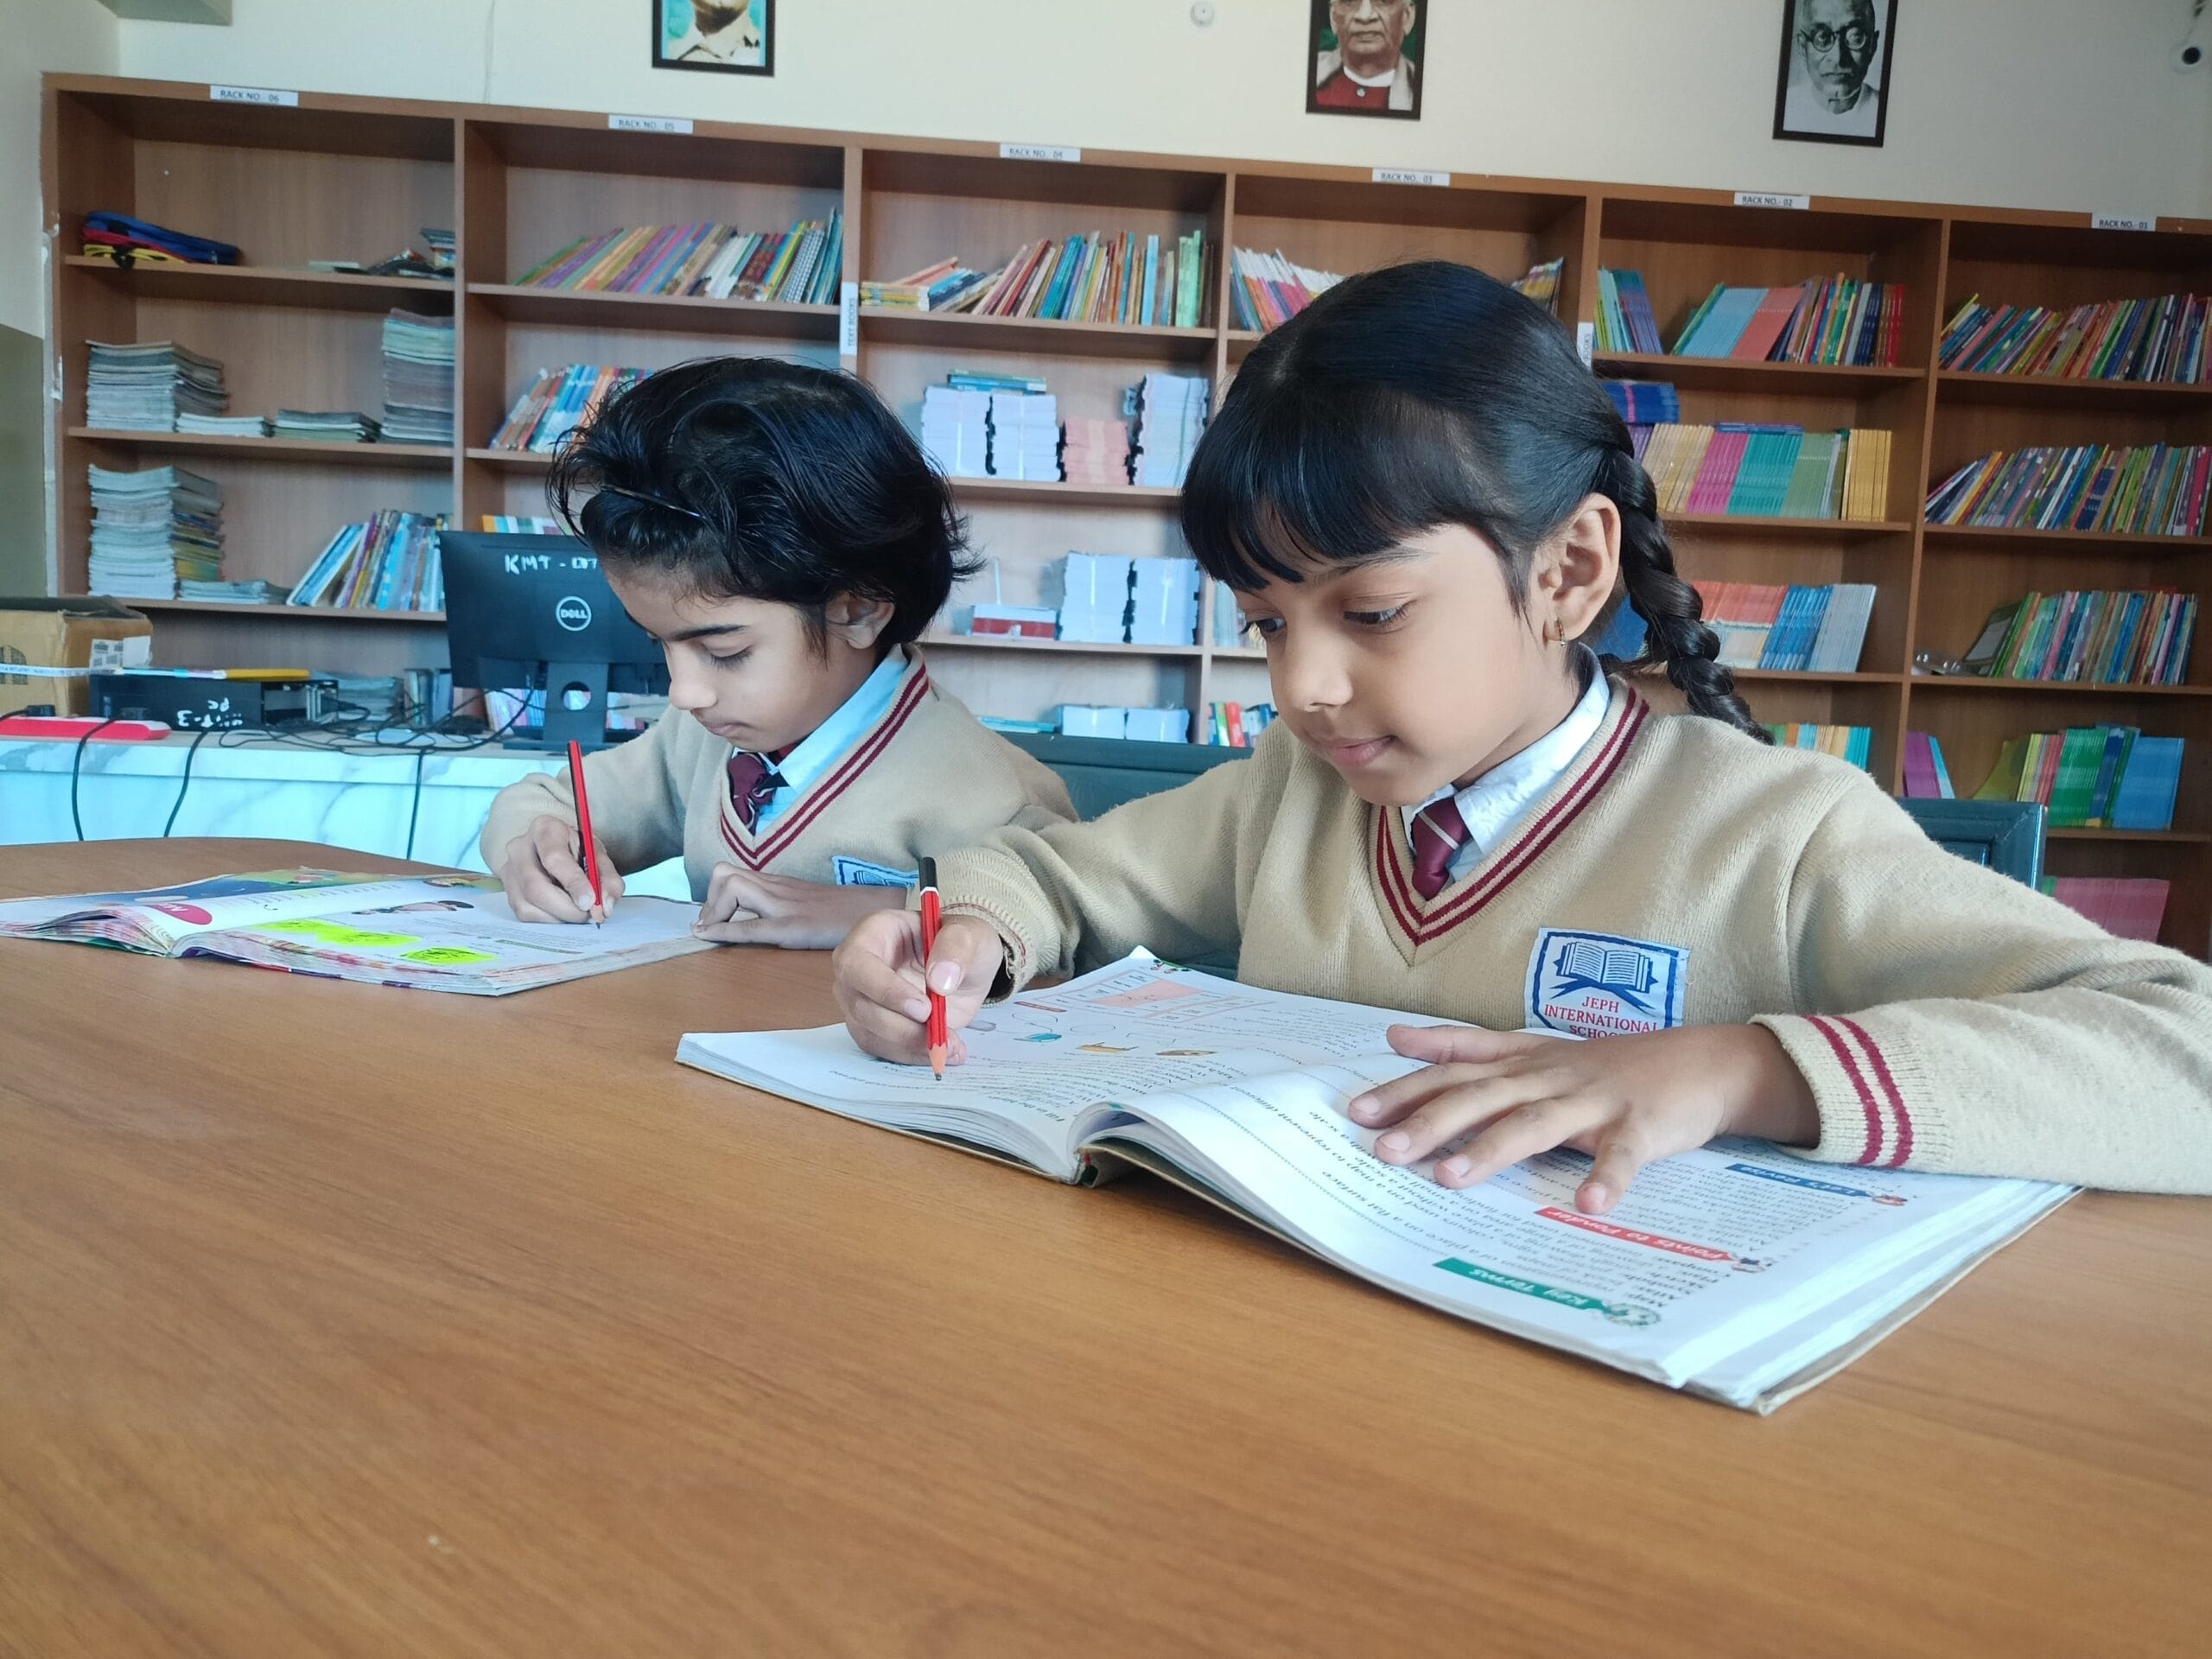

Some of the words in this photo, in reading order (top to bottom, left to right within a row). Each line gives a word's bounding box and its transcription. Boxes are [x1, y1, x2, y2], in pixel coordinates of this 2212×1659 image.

[220, 89, 244, 99] RACK
[268, 93, 280, 103] 06
[618, 119, 640, 128] RACK
[1009, 148, 1030, 156] RACK
[1052, 150, 1063, 159] 04
[1381, 172, 1402, 181] RACK
[1742, 195, 1763, 204] RACK
[1783, 198, 1793, 207] 02
[2099, 219, 2119, 228] RACK
[561, 609, 588, 619] DELL
[1581, 996, 1619, 1014] JEPH
[1230, 1084, 1278, 1114] different
[1306, 1111, 1339, 1132] scale
[1276, 1112, 1332, 1151] represent
[1329, 1152, 1345, 1161] to
[1344, 1162, 1375, 1181] map
[1351, 1156, 1388, 1177] scale
[1697, 1174, 1735, 1184] show
[1724, 1175, 1759, 1184] used
[1740, 1166, 1801, 1184] Revise
[1319, 1171, 1368, 1202] surface
[1409, 1180, 1446, 1199] small
[1509, 1181, 1549, 1198] place
[1685, 1185, 1724, 1194] show
[1694, 1180, 1733, 1190] show
[1737, 1183, 1779, 1194] maps
[1807, 1180, 1856, 1195] Let's
[1385, 1189, 1406, 1200] on
[1397, 1185, 1450, 1211] without
[1450, 1191, 1498, 1212] finding
[1692, 1192, 1770, 1210] represents
[1726, 1193, 1767, 1204] maps
[1736, 1189, 1777, 1199] maps
[1778, 1186, 1846, 1202] compass
[1367, 1202, 1389, 1217] flat
[1404, 1200, 1440, 1217] used
[1459, 1205, 1481, 1214] on
[1658, 1197, 1705, 1209] rough
[1700, 1200, 1782, 1219] landmarks
[1769, 1203, 1833, 1218] Political
[1777, 1198, 1843, 1214] Physical
[1448, 1211, 1491, 1229] place
[1481, 1215, 1515, 1227] area
[1500, 1212, 1521, 1221] for
[1636, 1213, 1675, 1224] book
[1736, 1215, 1783, 1227] sketch
[1770, 1209, 1808, 1218] plan
[1402, 1223, 1426, 1232] on
[1440, 1218, 1495, 1240] colours
[1520, 1220, 1560, 1233] used
[1547, 1209, 1622, 1237] Ponder
[1423, 1232, 1466, 1250] place
[1515, 1226, 1551, 1241] large
[1628, 1230, 1649, 1242] to
[1706, 1229, 1744, 1238] atlas
[1522, 1237, 1587, 1259] drawing
[1560, 1232, 1644, 1256] instrument
[1655, 1238, 1723, 1260] Points
[1707, 1236, 1745, 1247] map
[1514, 1255, 1560, 1268] maps
[1588, 1247, 1653, 1268] drawing
[1589, 1255, 1637, 1270] rough
[1469, 1268, 1535, 1294] Terms
[1499, 1259, 1616, 1293] representation
[1580, 1272, 1624, 1286] book
[1542, 1288, 1588, 1305] Key
